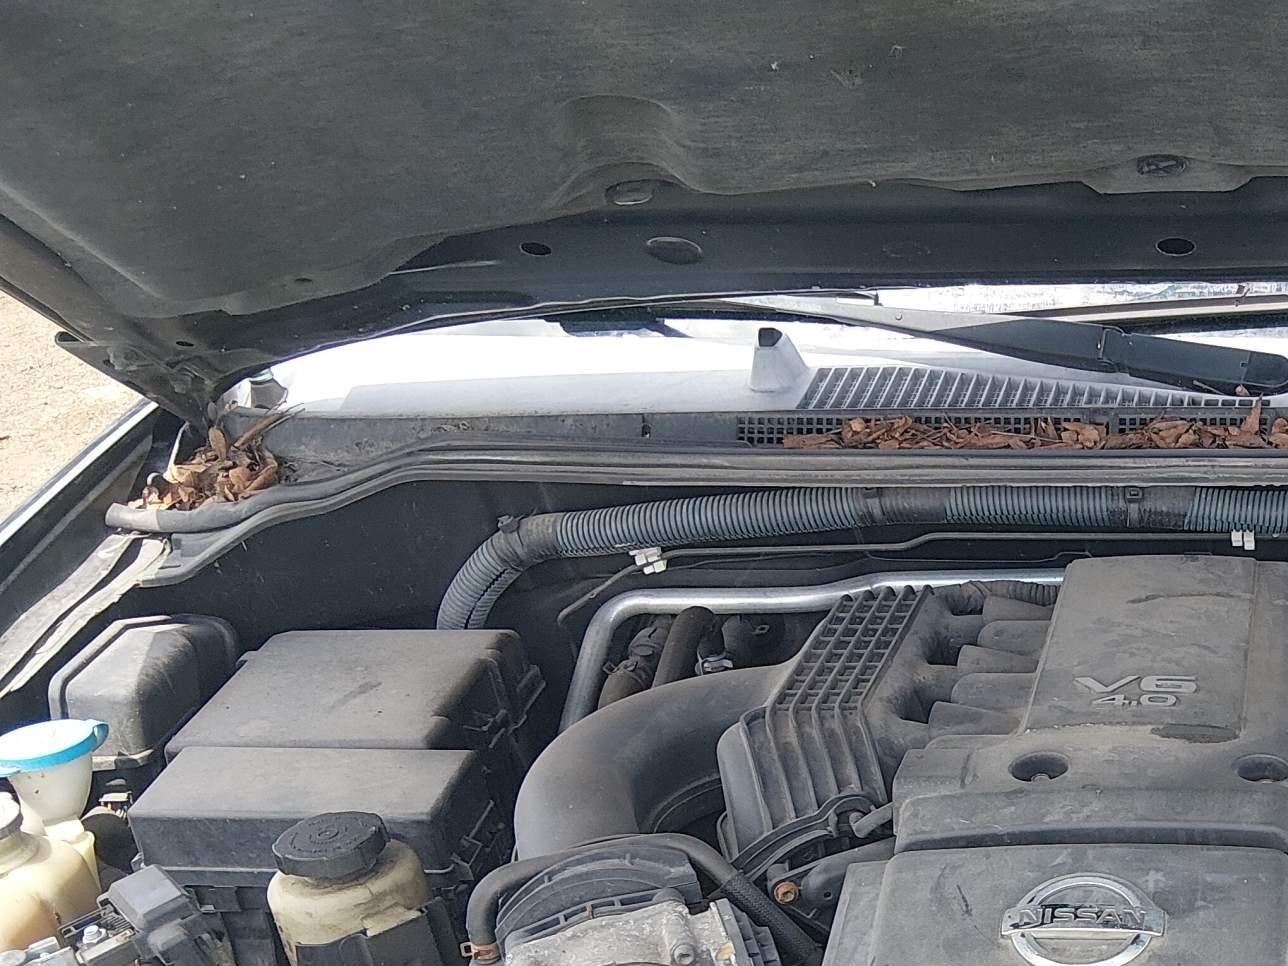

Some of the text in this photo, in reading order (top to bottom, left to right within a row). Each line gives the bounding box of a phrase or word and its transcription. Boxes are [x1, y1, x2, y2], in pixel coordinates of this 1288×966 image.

[1074, 675, 1198, 693] V6
[1092, 694, 1178, 706] 4.0
[1017, 907, 1147, 927] NISSAN
